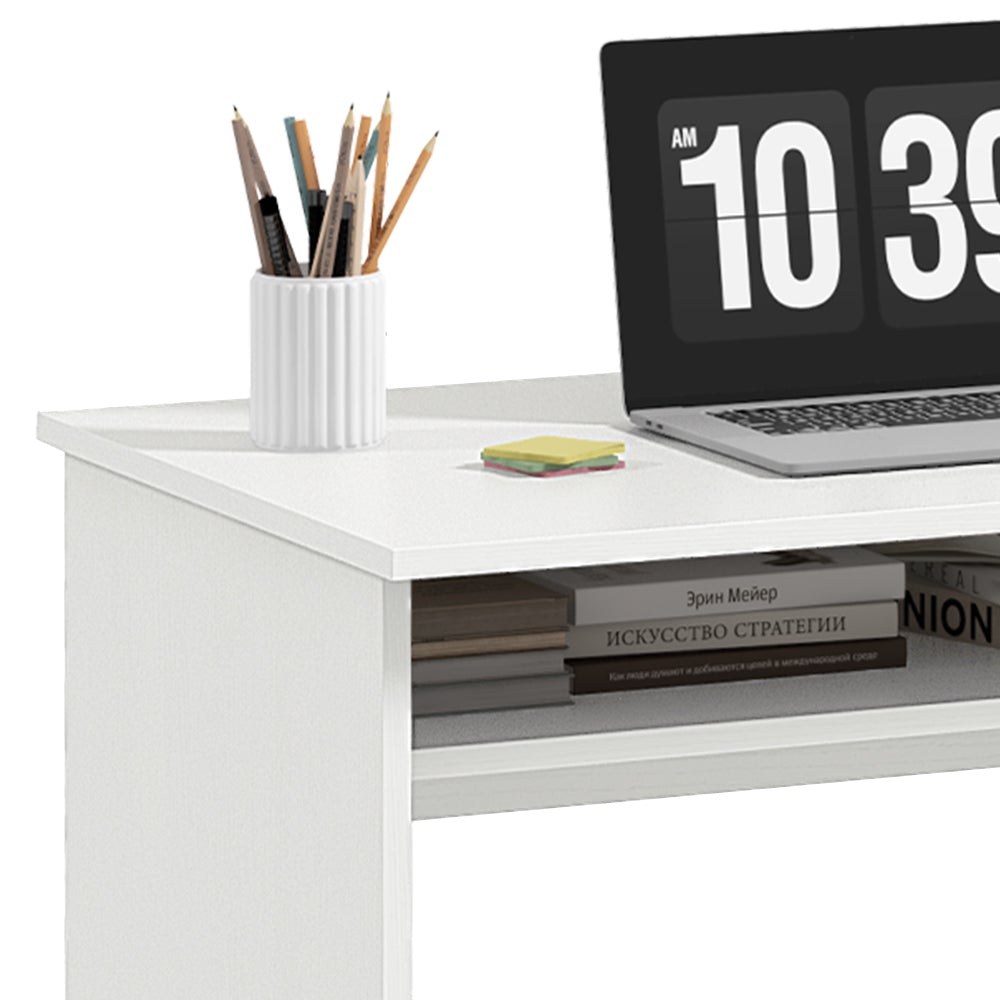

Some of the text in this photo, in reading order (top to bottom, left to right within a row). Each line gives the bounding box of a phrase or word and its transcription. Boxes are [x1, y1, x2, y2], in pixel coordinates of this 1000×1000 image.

[671, 126, 698, 149] AM
[680, 120, 841, 311] 10
[687, 585, 778, 610] Эрин Мейер
[607, 616, 847, 647] ИСКУССТВО СТРАТЕГИИ
